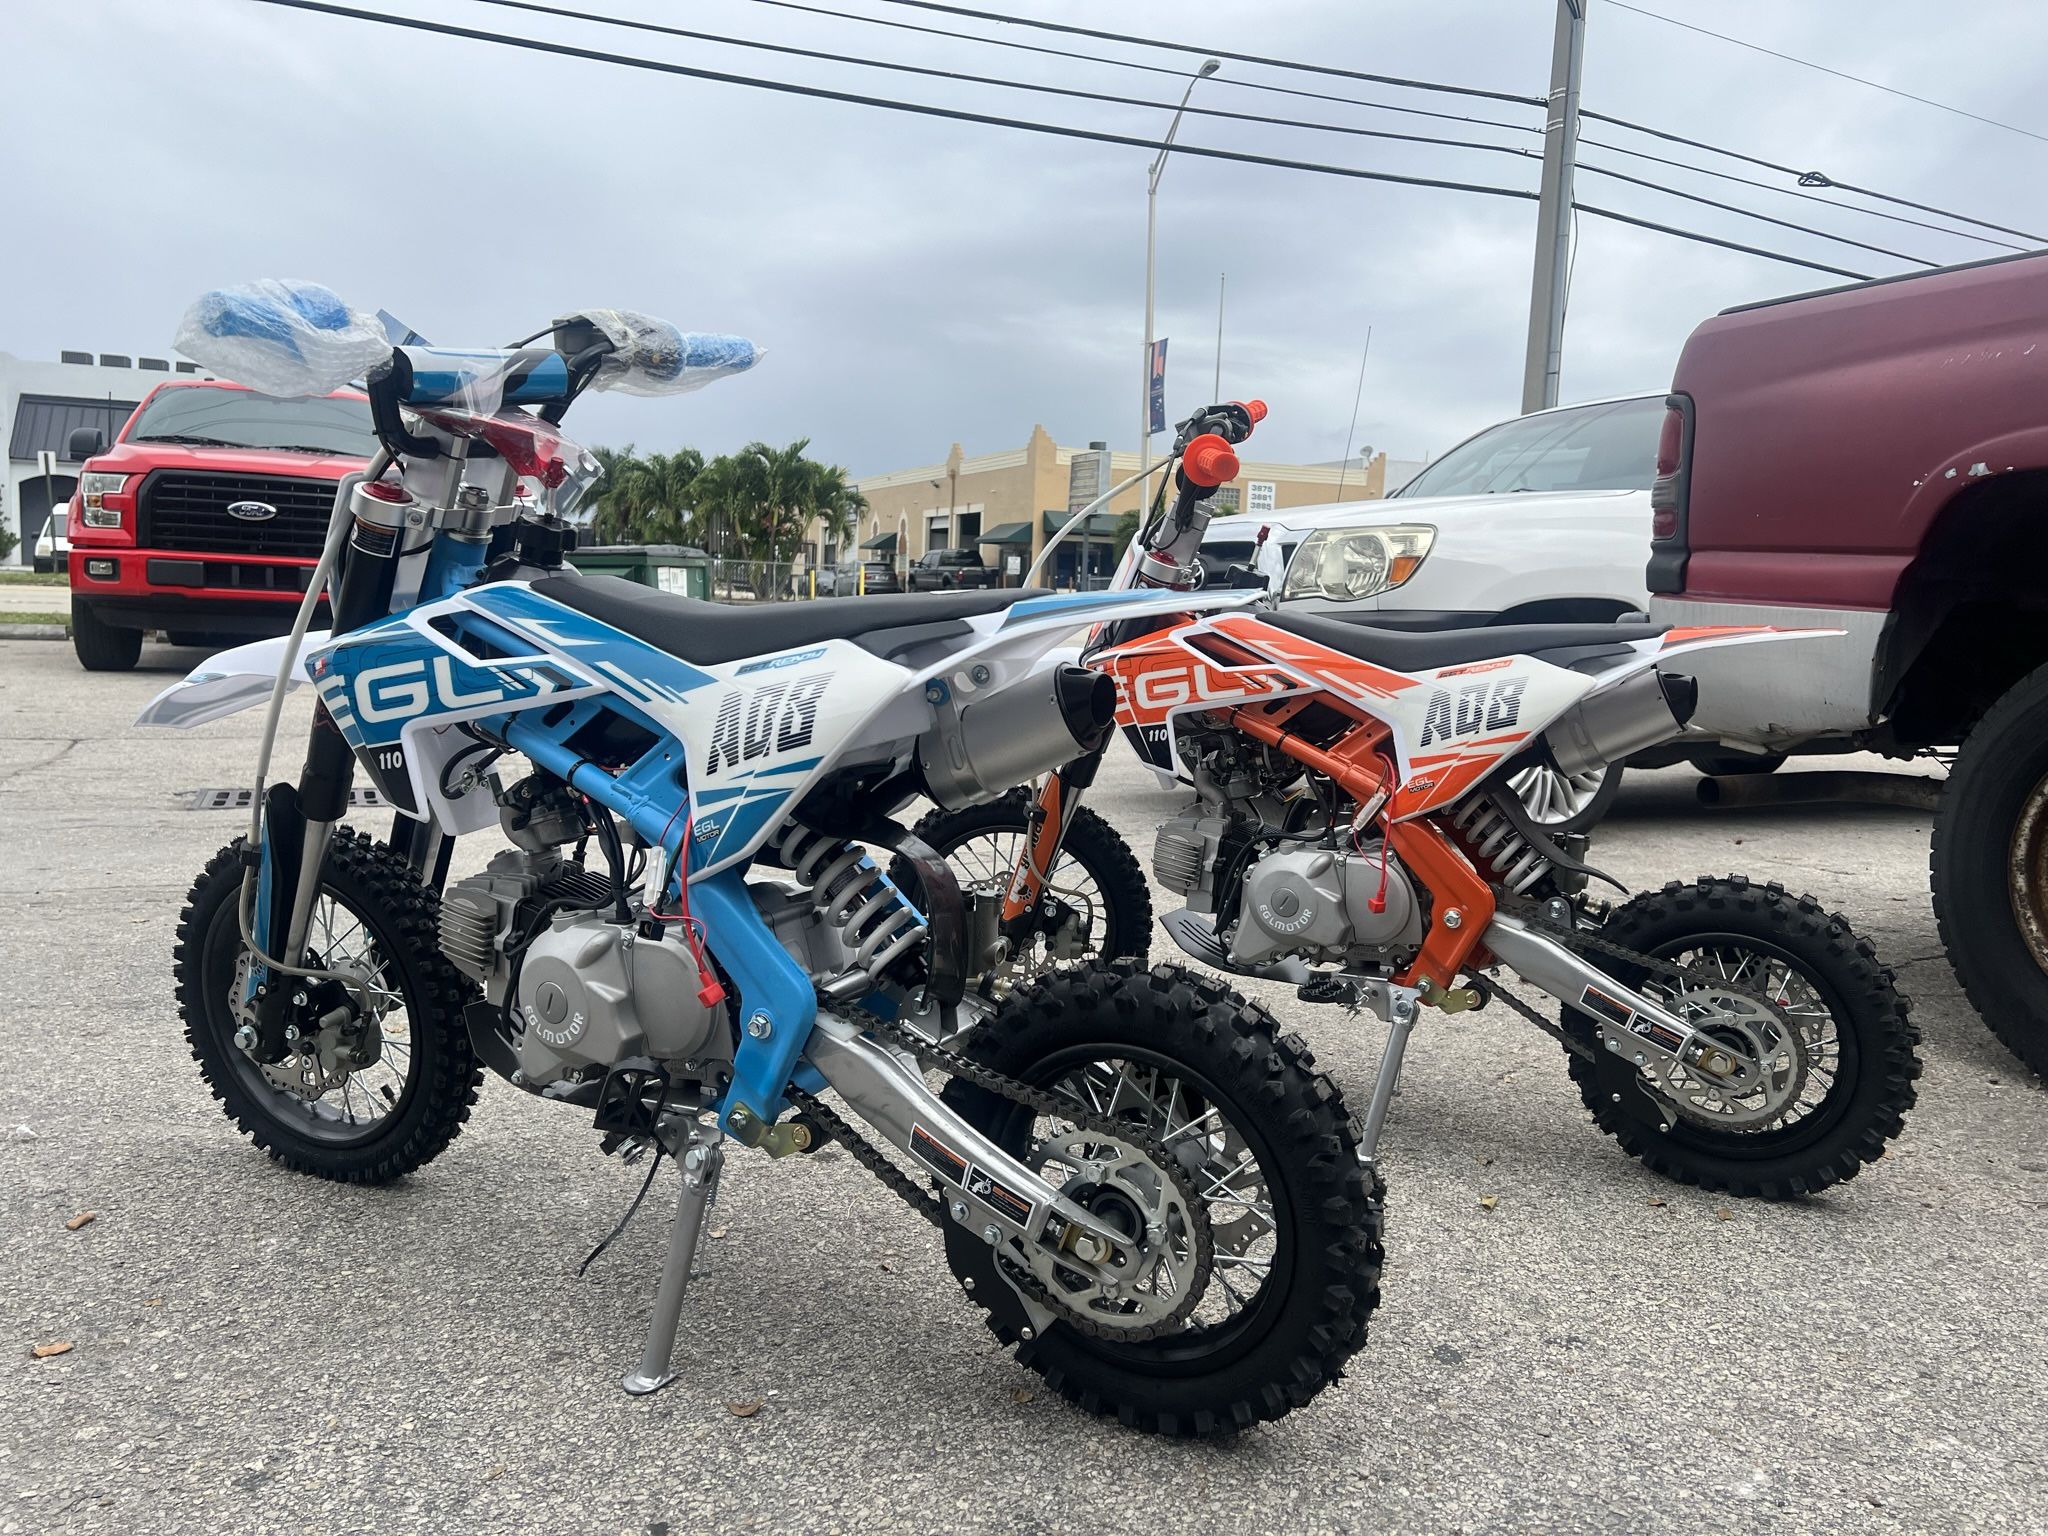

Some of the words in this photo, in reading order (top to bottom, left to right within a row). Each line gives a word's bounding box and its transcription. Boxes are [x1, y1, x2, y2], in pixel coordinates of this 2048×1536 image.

[1148, 728, 1168, 742] 110
[378, 751, 402, 770] 110
[1407, 776, 1434, 789] EGL
[1408, 782, 1434, 793] MOTOR
[693, 819, 720, 837] EGL
[696, 829, 720, 844] MOTOR
[1260, 904, 1313, 932] EGLMOTOR
[524, 1005, 585, 1044] EGLMOTOR
